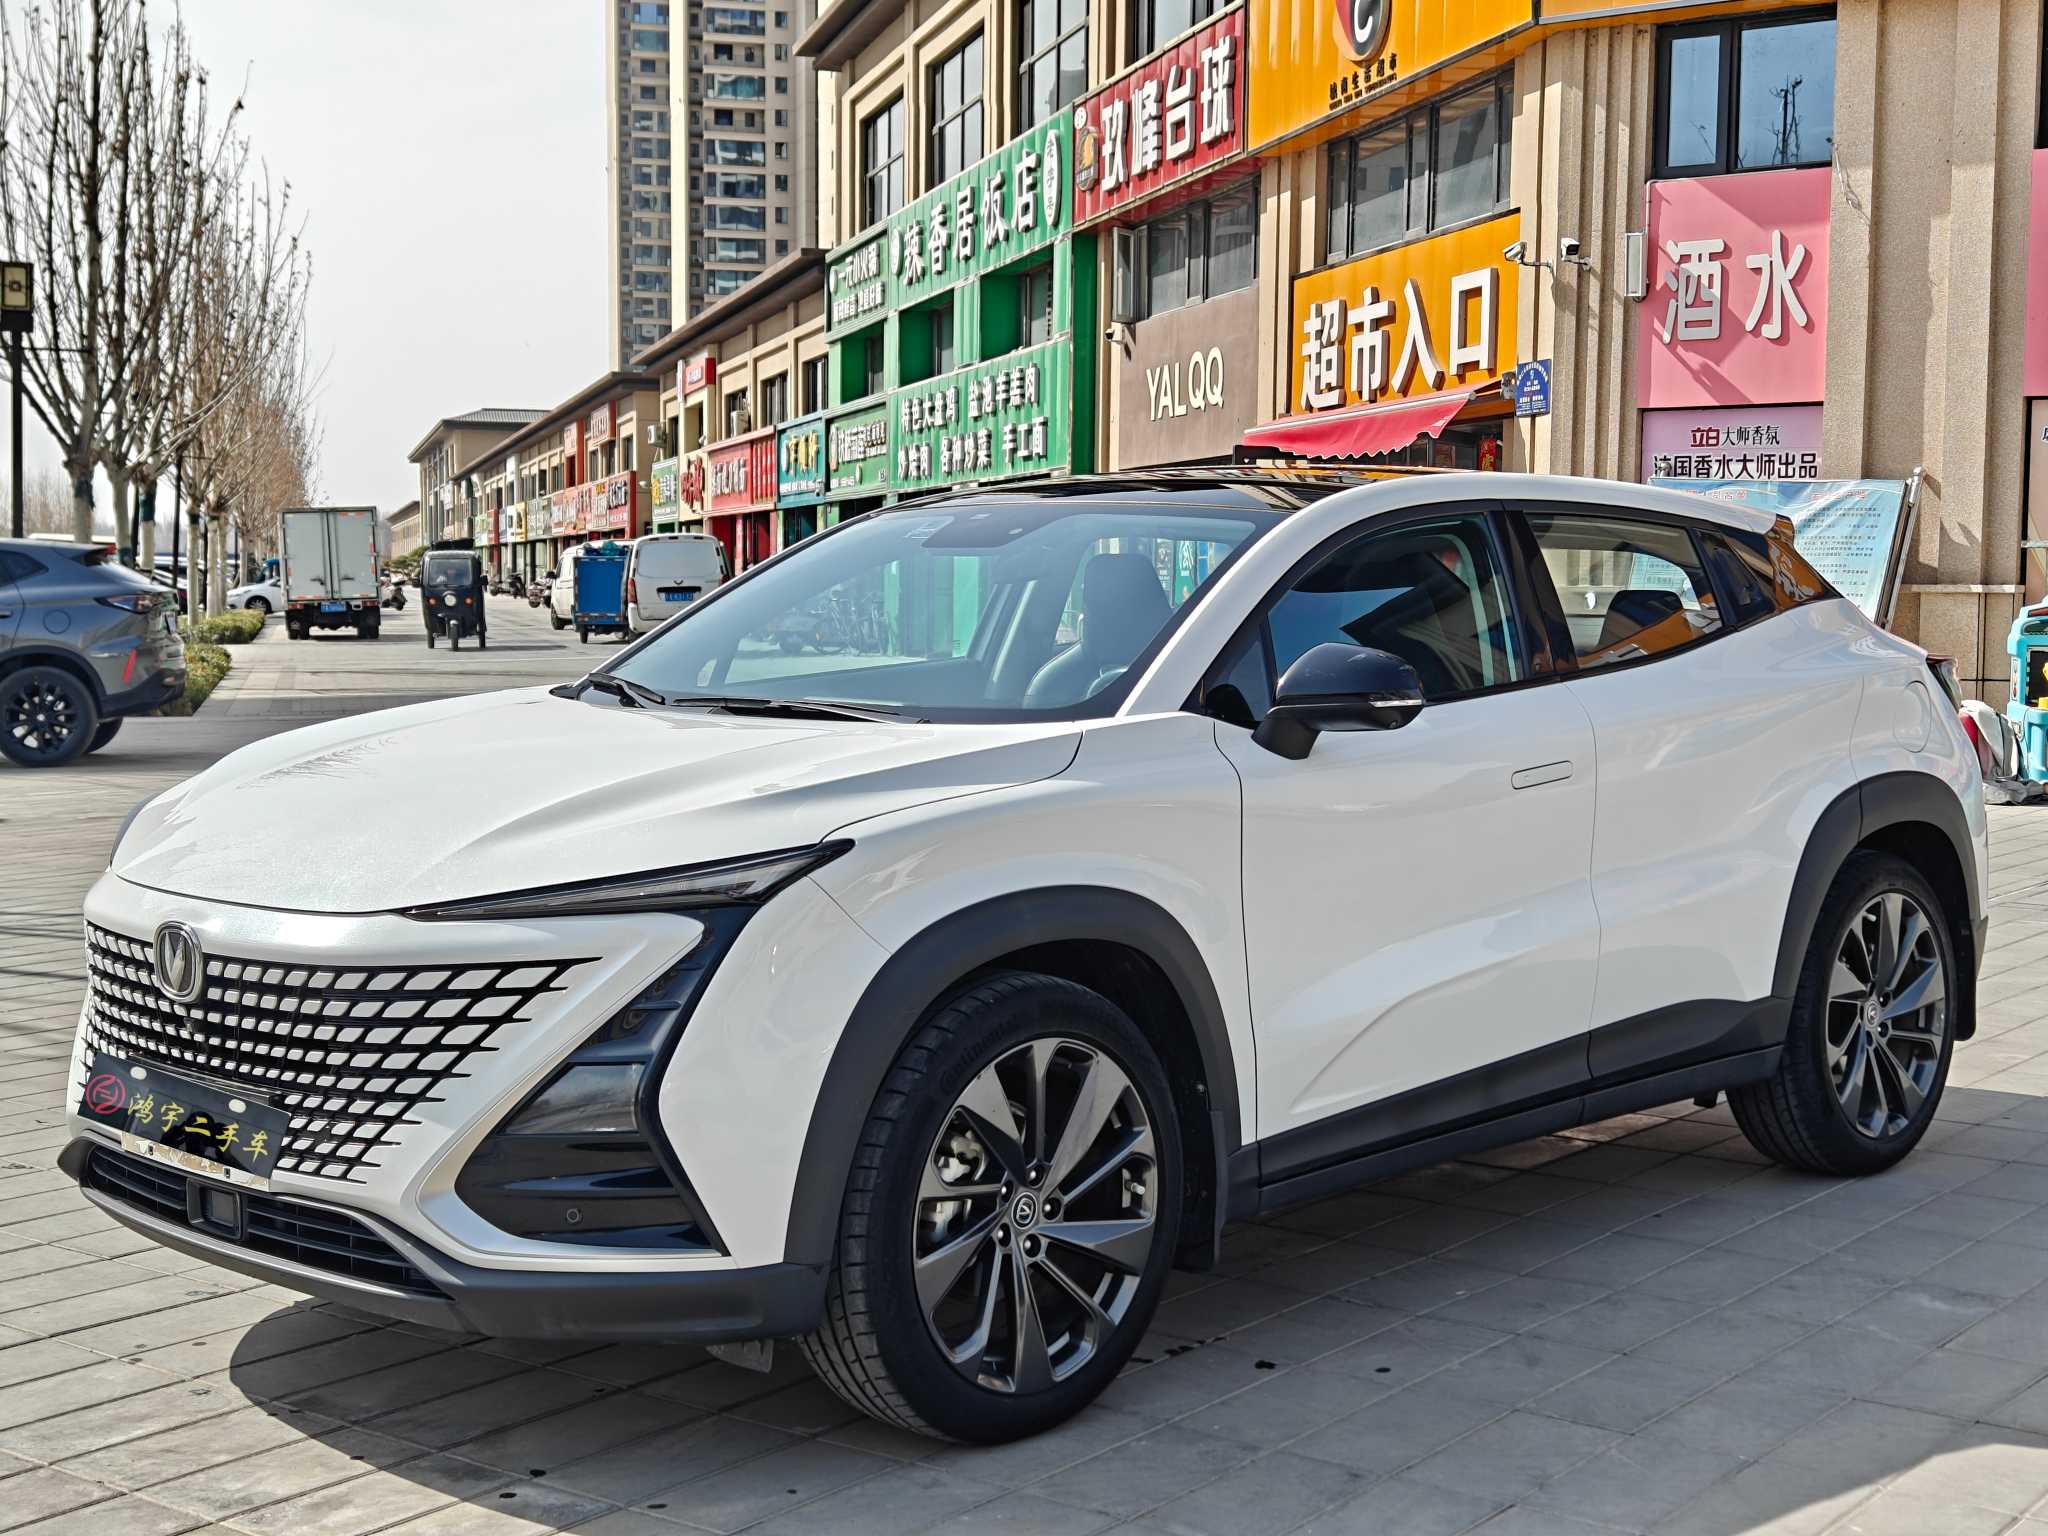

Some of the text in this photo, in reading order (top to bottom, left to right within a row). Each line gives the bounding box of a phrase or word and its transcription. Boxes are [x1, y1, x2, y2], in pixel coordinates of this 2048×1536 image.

[1101, 35, 1234, 192] 玖峰台球
[903, 149, 1041, 286] 辣香居饭店
[1663, 229, 1808, 345] 酒水
[1301, 267, 1498, 409] 超市入口
[902, 384, 959, 434] 特色大盘鸡
[1146, 346, 1224, 421] YALQQ
[941, 428, 992, 474] 各种炒菜
[1002, 416, 1048, 464] 手工面
[127, 1091, 269, 1163] 鸿宇二手车
